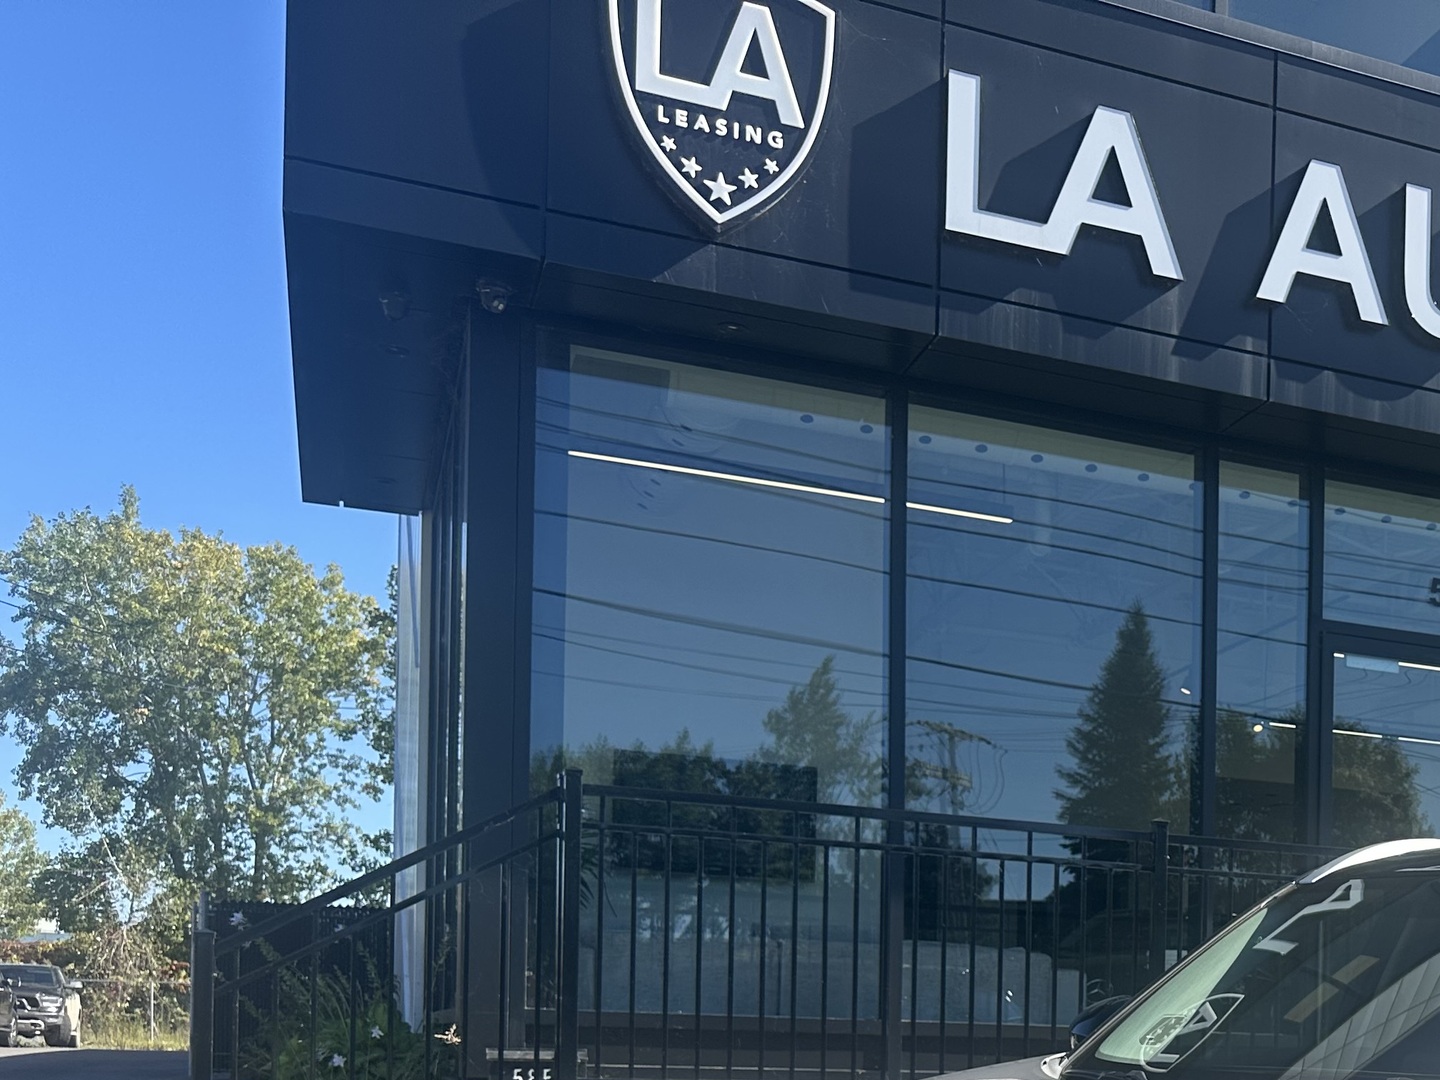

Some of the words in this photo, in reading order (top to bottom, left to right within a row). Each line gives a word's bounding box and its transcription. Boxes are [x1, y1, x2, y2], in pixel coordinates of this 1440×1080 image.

[635, 0, 804, 129] LA
[657, 104, 784, 149] LEASING
[945, 69, 1184, 282] LA
